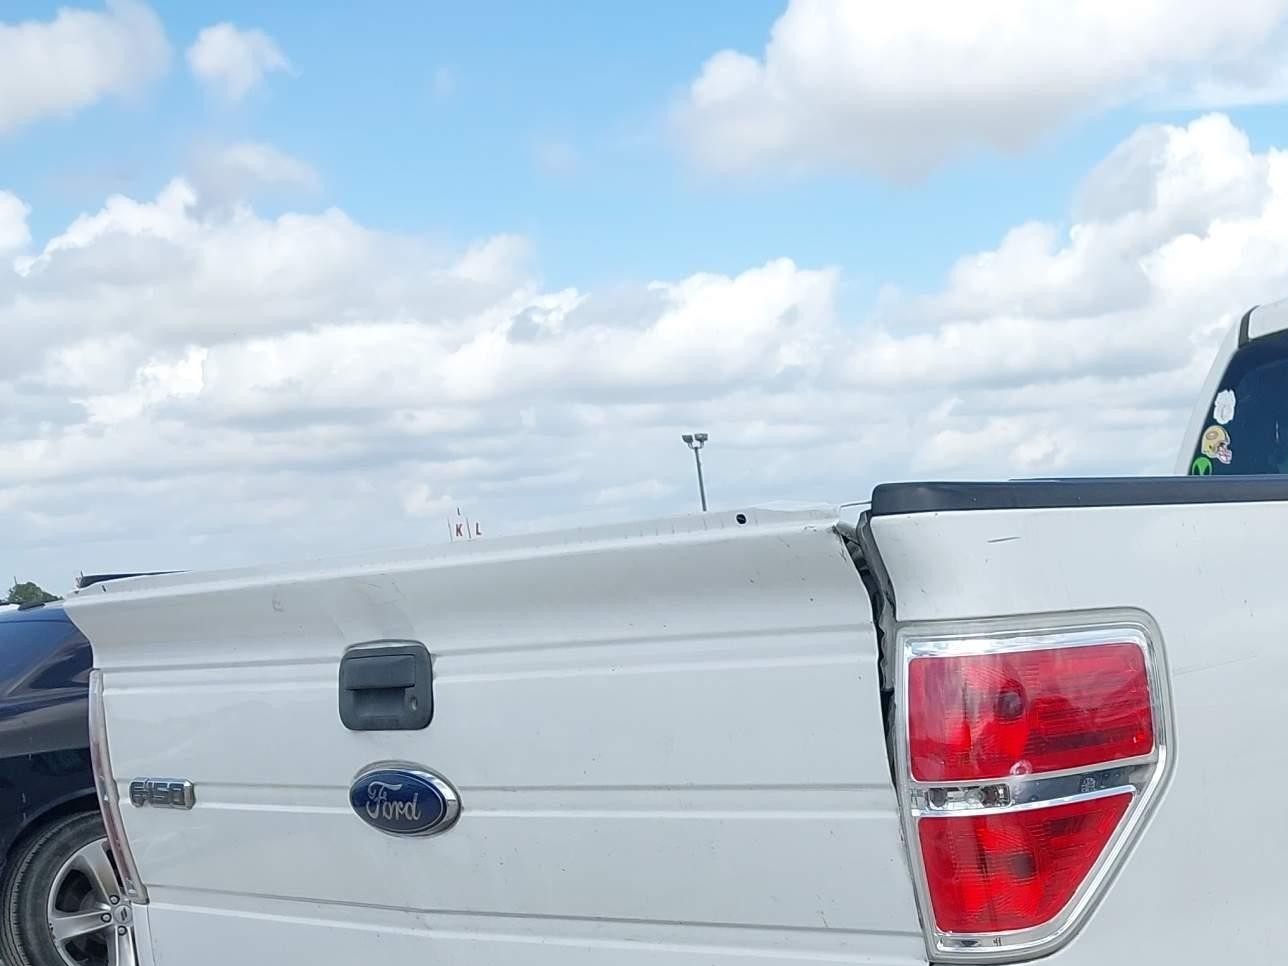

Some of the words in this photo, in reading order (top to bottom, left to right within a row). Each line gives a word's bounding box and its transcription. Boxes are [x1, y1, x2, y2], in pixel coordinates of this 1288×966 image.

[455, 523, 463, 537] K
[475, 522, 482, 536] L
[366, 780, 421, 821] Ford
